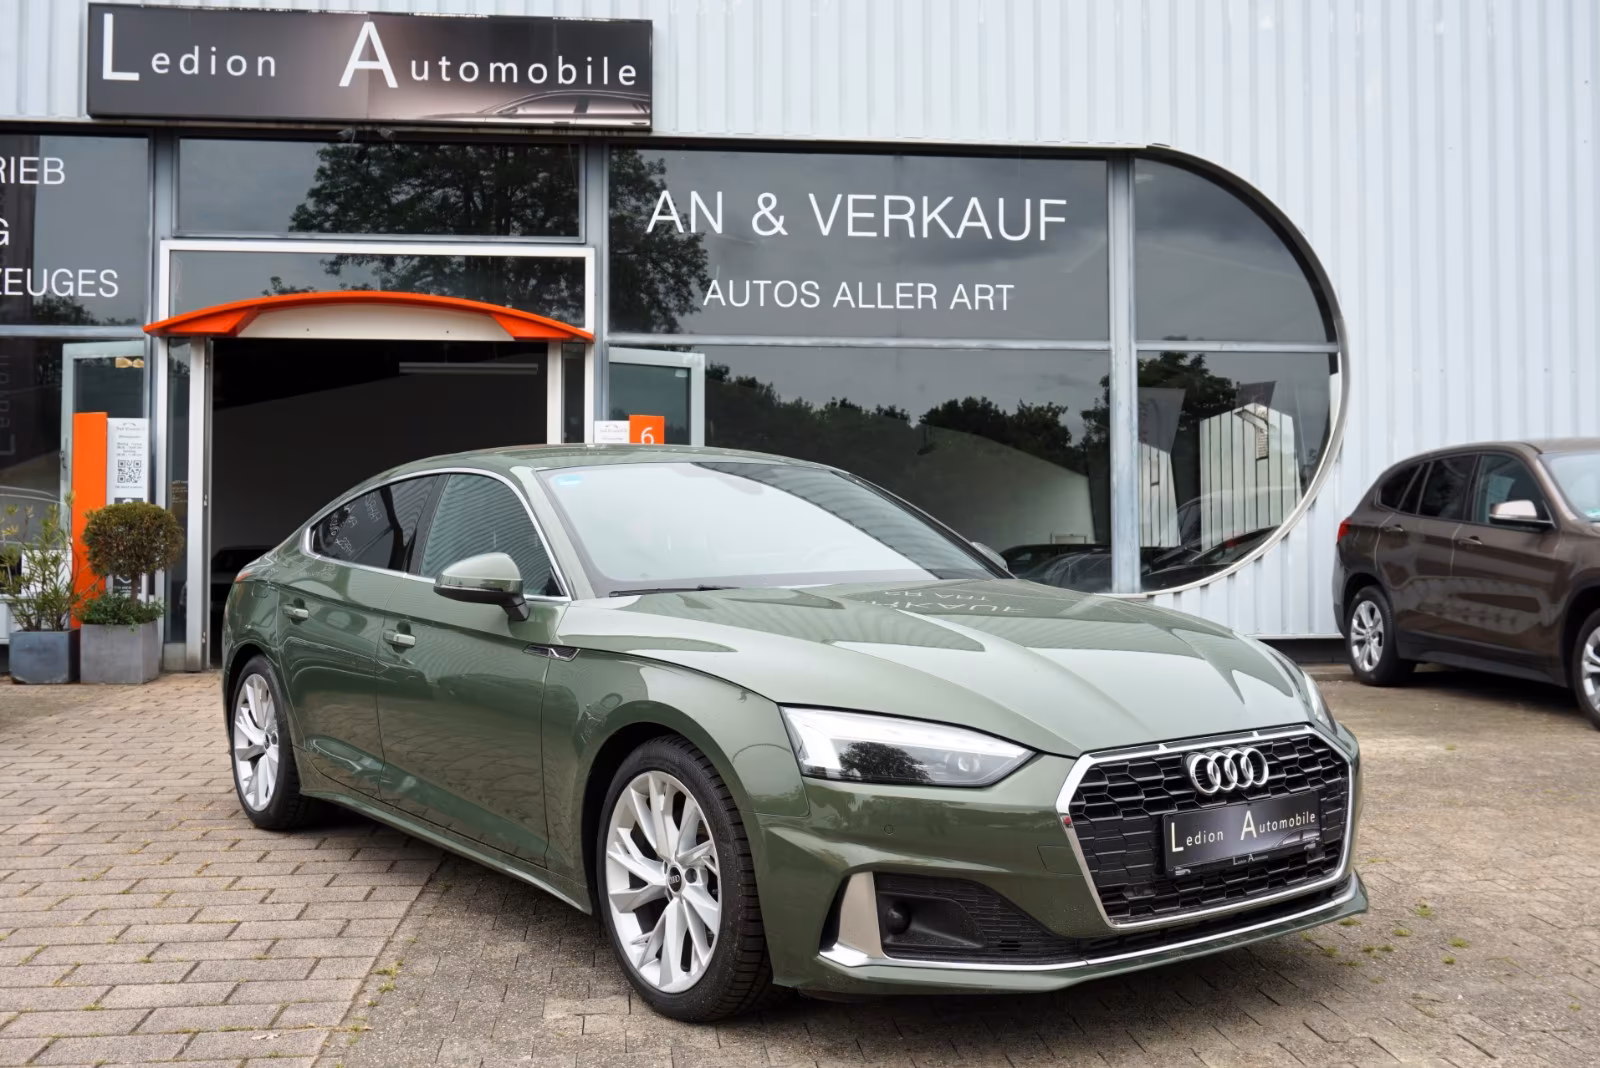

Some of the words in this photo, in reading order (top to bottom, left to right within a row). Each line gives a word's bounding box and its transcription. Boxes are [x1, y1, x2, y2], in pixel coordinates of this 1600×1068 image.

[103, 13, 276, 81] Ledion
[338, 21, 637, 88] Automobile
[0, 156, 65, 185] IEB
[646, 190, 723, 234] AN
[751, 192, 789, 236] &
[808, 193, 1067, 241] VERKAUF
[0, 268, 119, 298] EUGES
[702, 279, 821, 309] AUTOS
[832, 281, 938, 310] ALLER
[949, 283, 1015, 311] ART
[641, 426, 655, 445] 6
[1170, 822, 1224, 852] Ledion
[1240, 810, 1316, 841] Automobile
